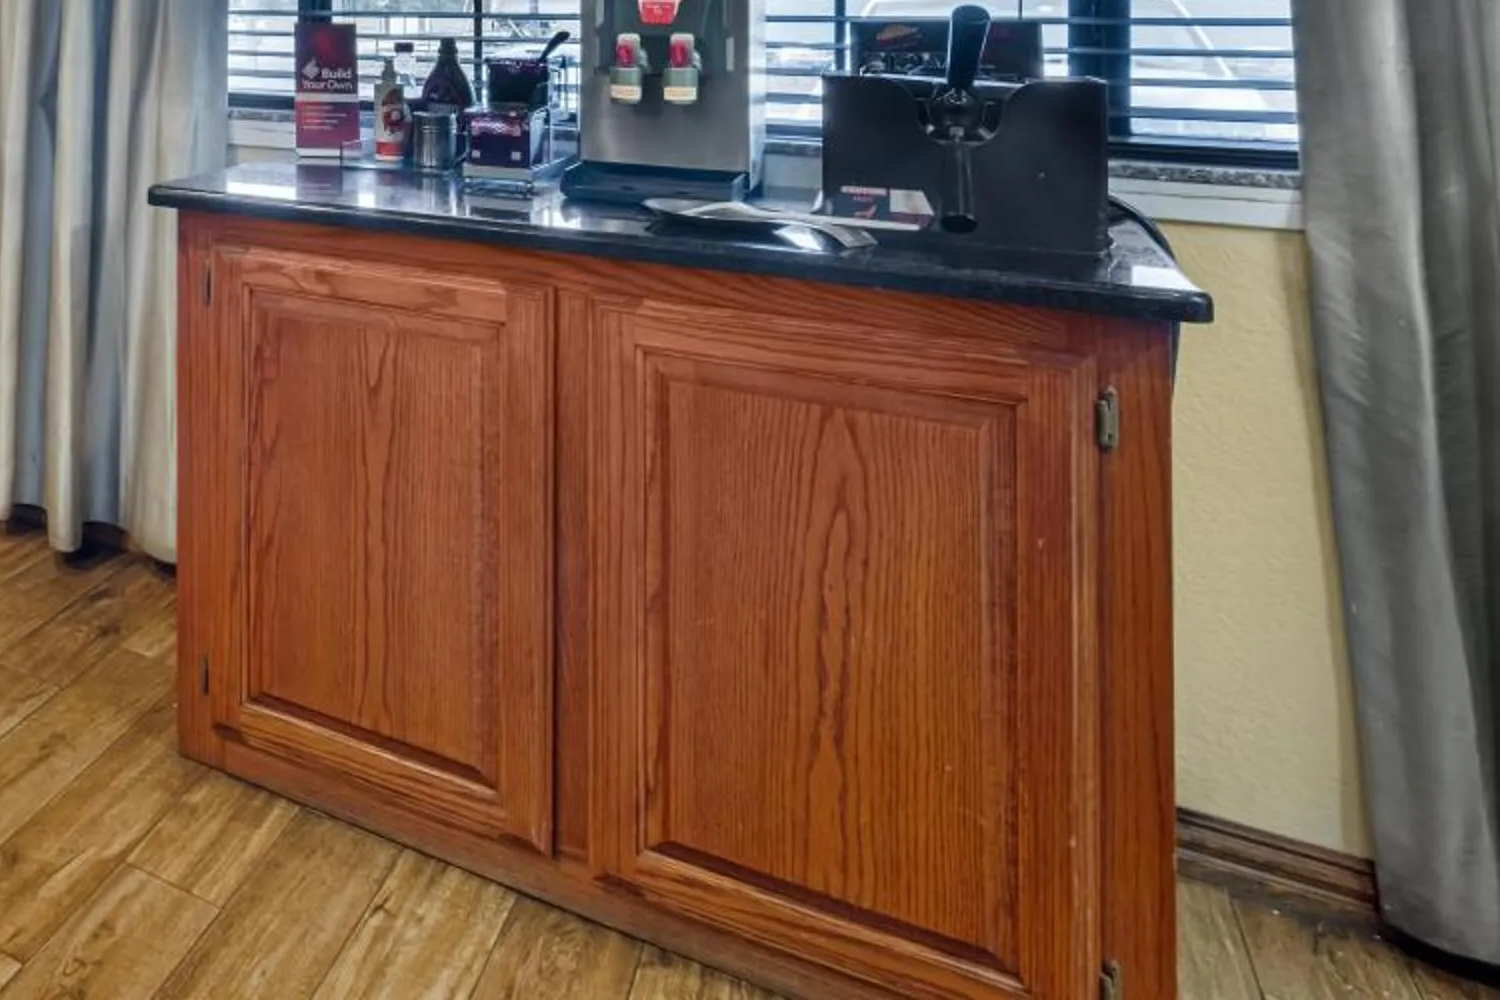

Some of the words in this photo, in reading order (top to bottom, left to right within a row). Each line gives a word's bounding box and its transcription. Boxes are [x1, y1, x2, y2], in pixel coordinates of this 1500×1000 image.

[322, 67, 353, 79] Build
[302, 79, 327, 89] Your
[328, 79, 354, 89] Own
